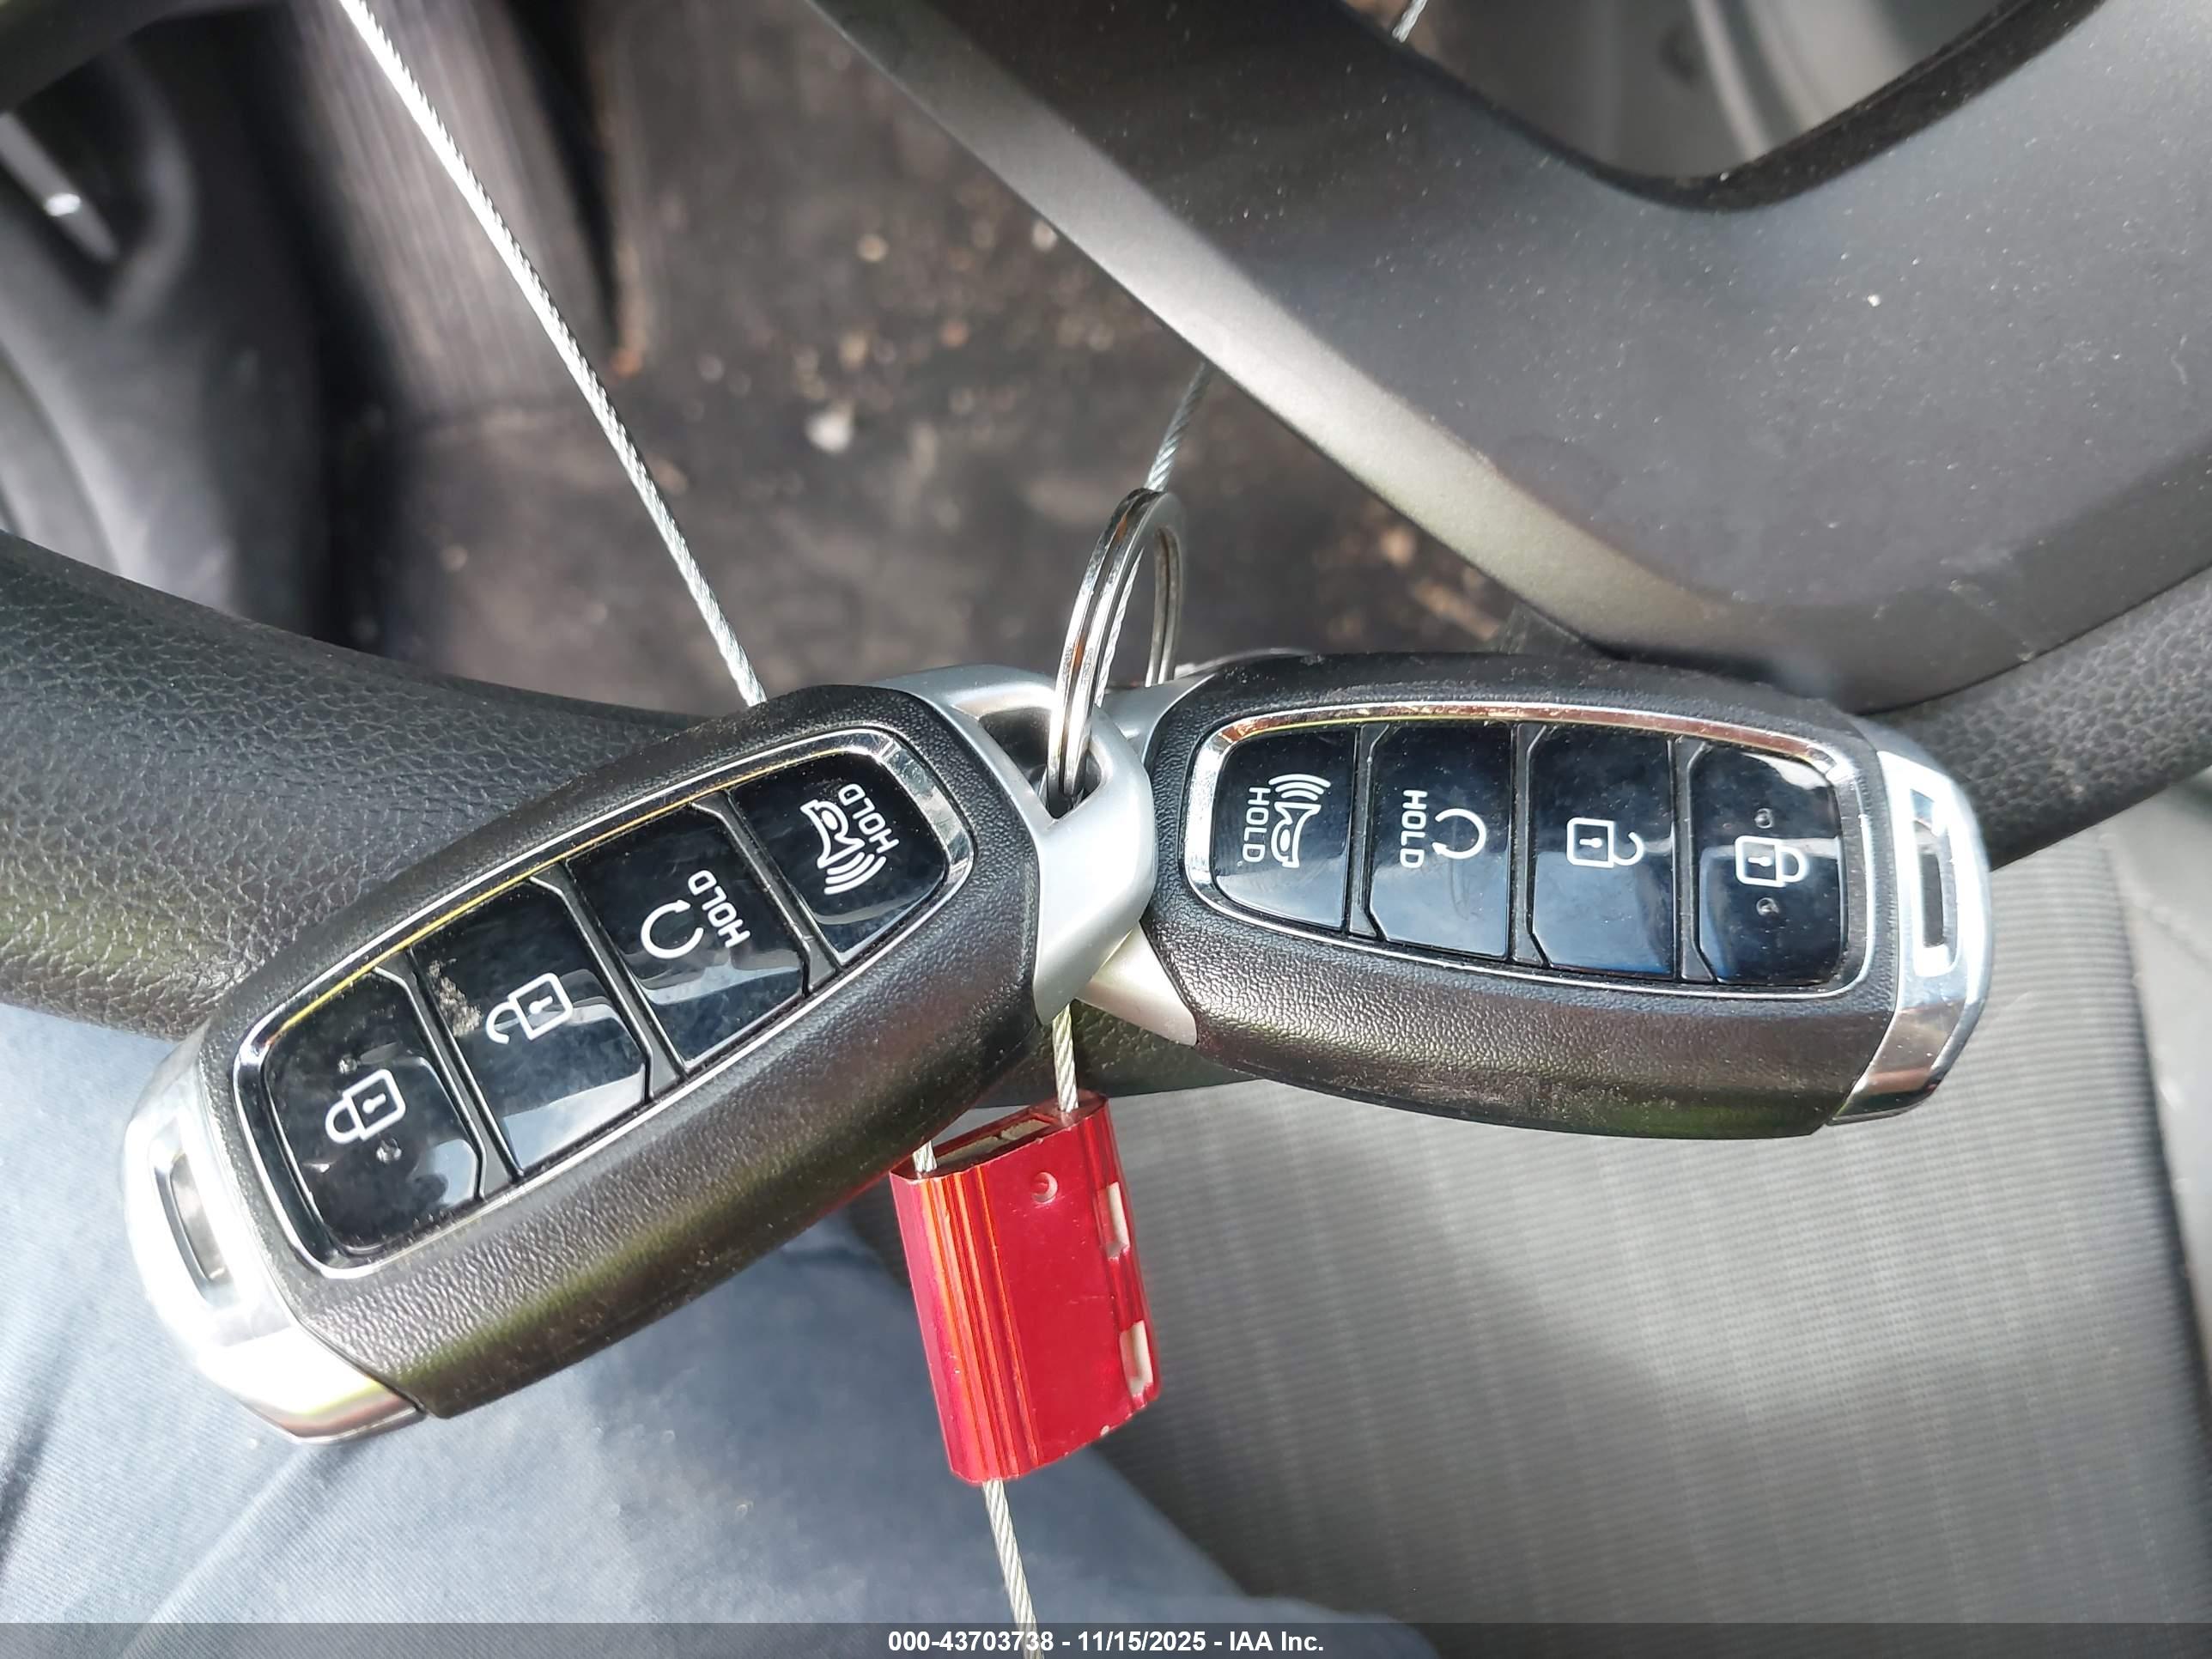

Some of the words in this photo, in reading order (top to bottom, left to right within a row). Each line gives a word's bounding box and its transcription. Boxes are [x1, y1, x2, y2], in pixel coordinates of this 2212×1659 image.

[837, 783, 900, 854] HOLD
[1242, 787, 1272, 863] HOLD
[1400, 789, 1428, 869] HOLD
[687, 870, 751, 949] HOLD
